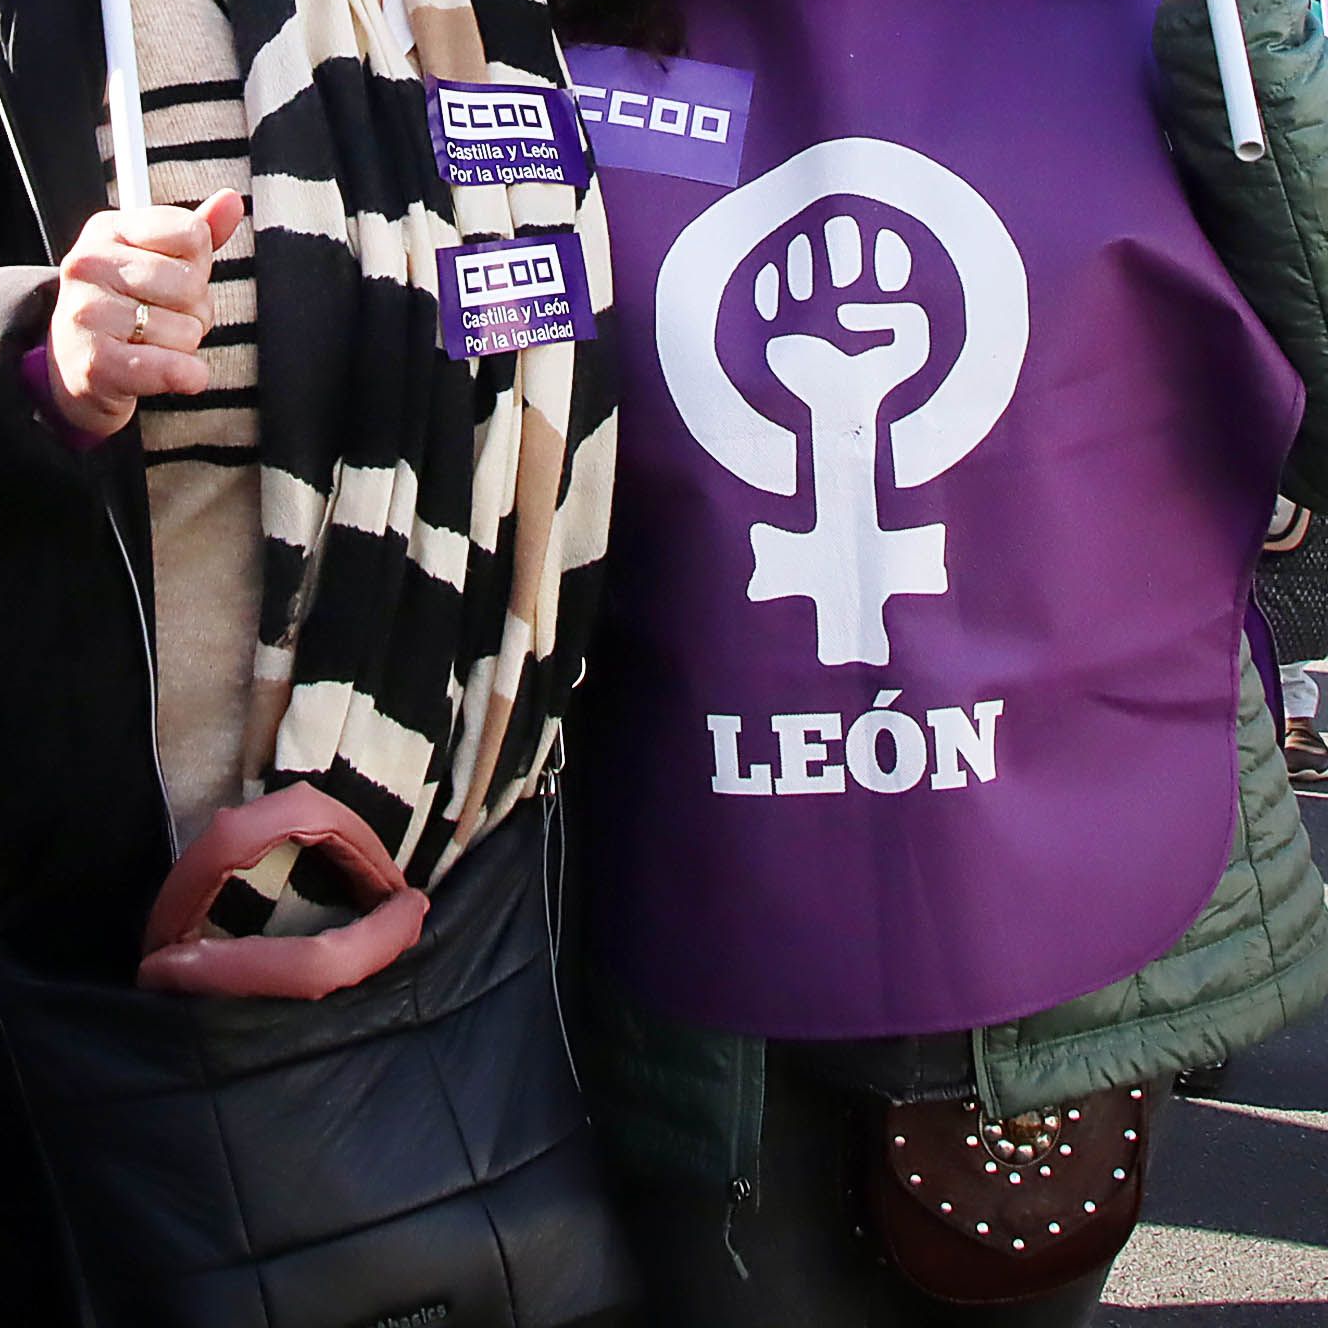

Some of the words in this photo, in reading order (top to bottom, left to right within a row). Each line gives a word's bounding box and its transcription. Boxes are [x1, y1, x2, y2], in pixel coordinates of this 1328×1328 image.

[444, 98, 547, 132] CCOO
[573, 84, 731, 144] CCOO
[446, 141, 505, 160] Castilla
[508, 143, 517, 162] y
[522, 142, 560, 160] León
[449, 163, 473, 184] Por
[476, 164, 494, 183] la
[496, 162, 564, 184] igualdad
[460, 251, 559, 299] CCOO
[462, 306, 520, 329] Castilla
[522, 304, 532, 322] y
[533, 297, 570, 318] León
[465, 334, 489, 354] Por
[491, 329, 509, 349] la
[511, 320, 574, 348] igualdad
[707, 690, 1004, 796] LEÓN
